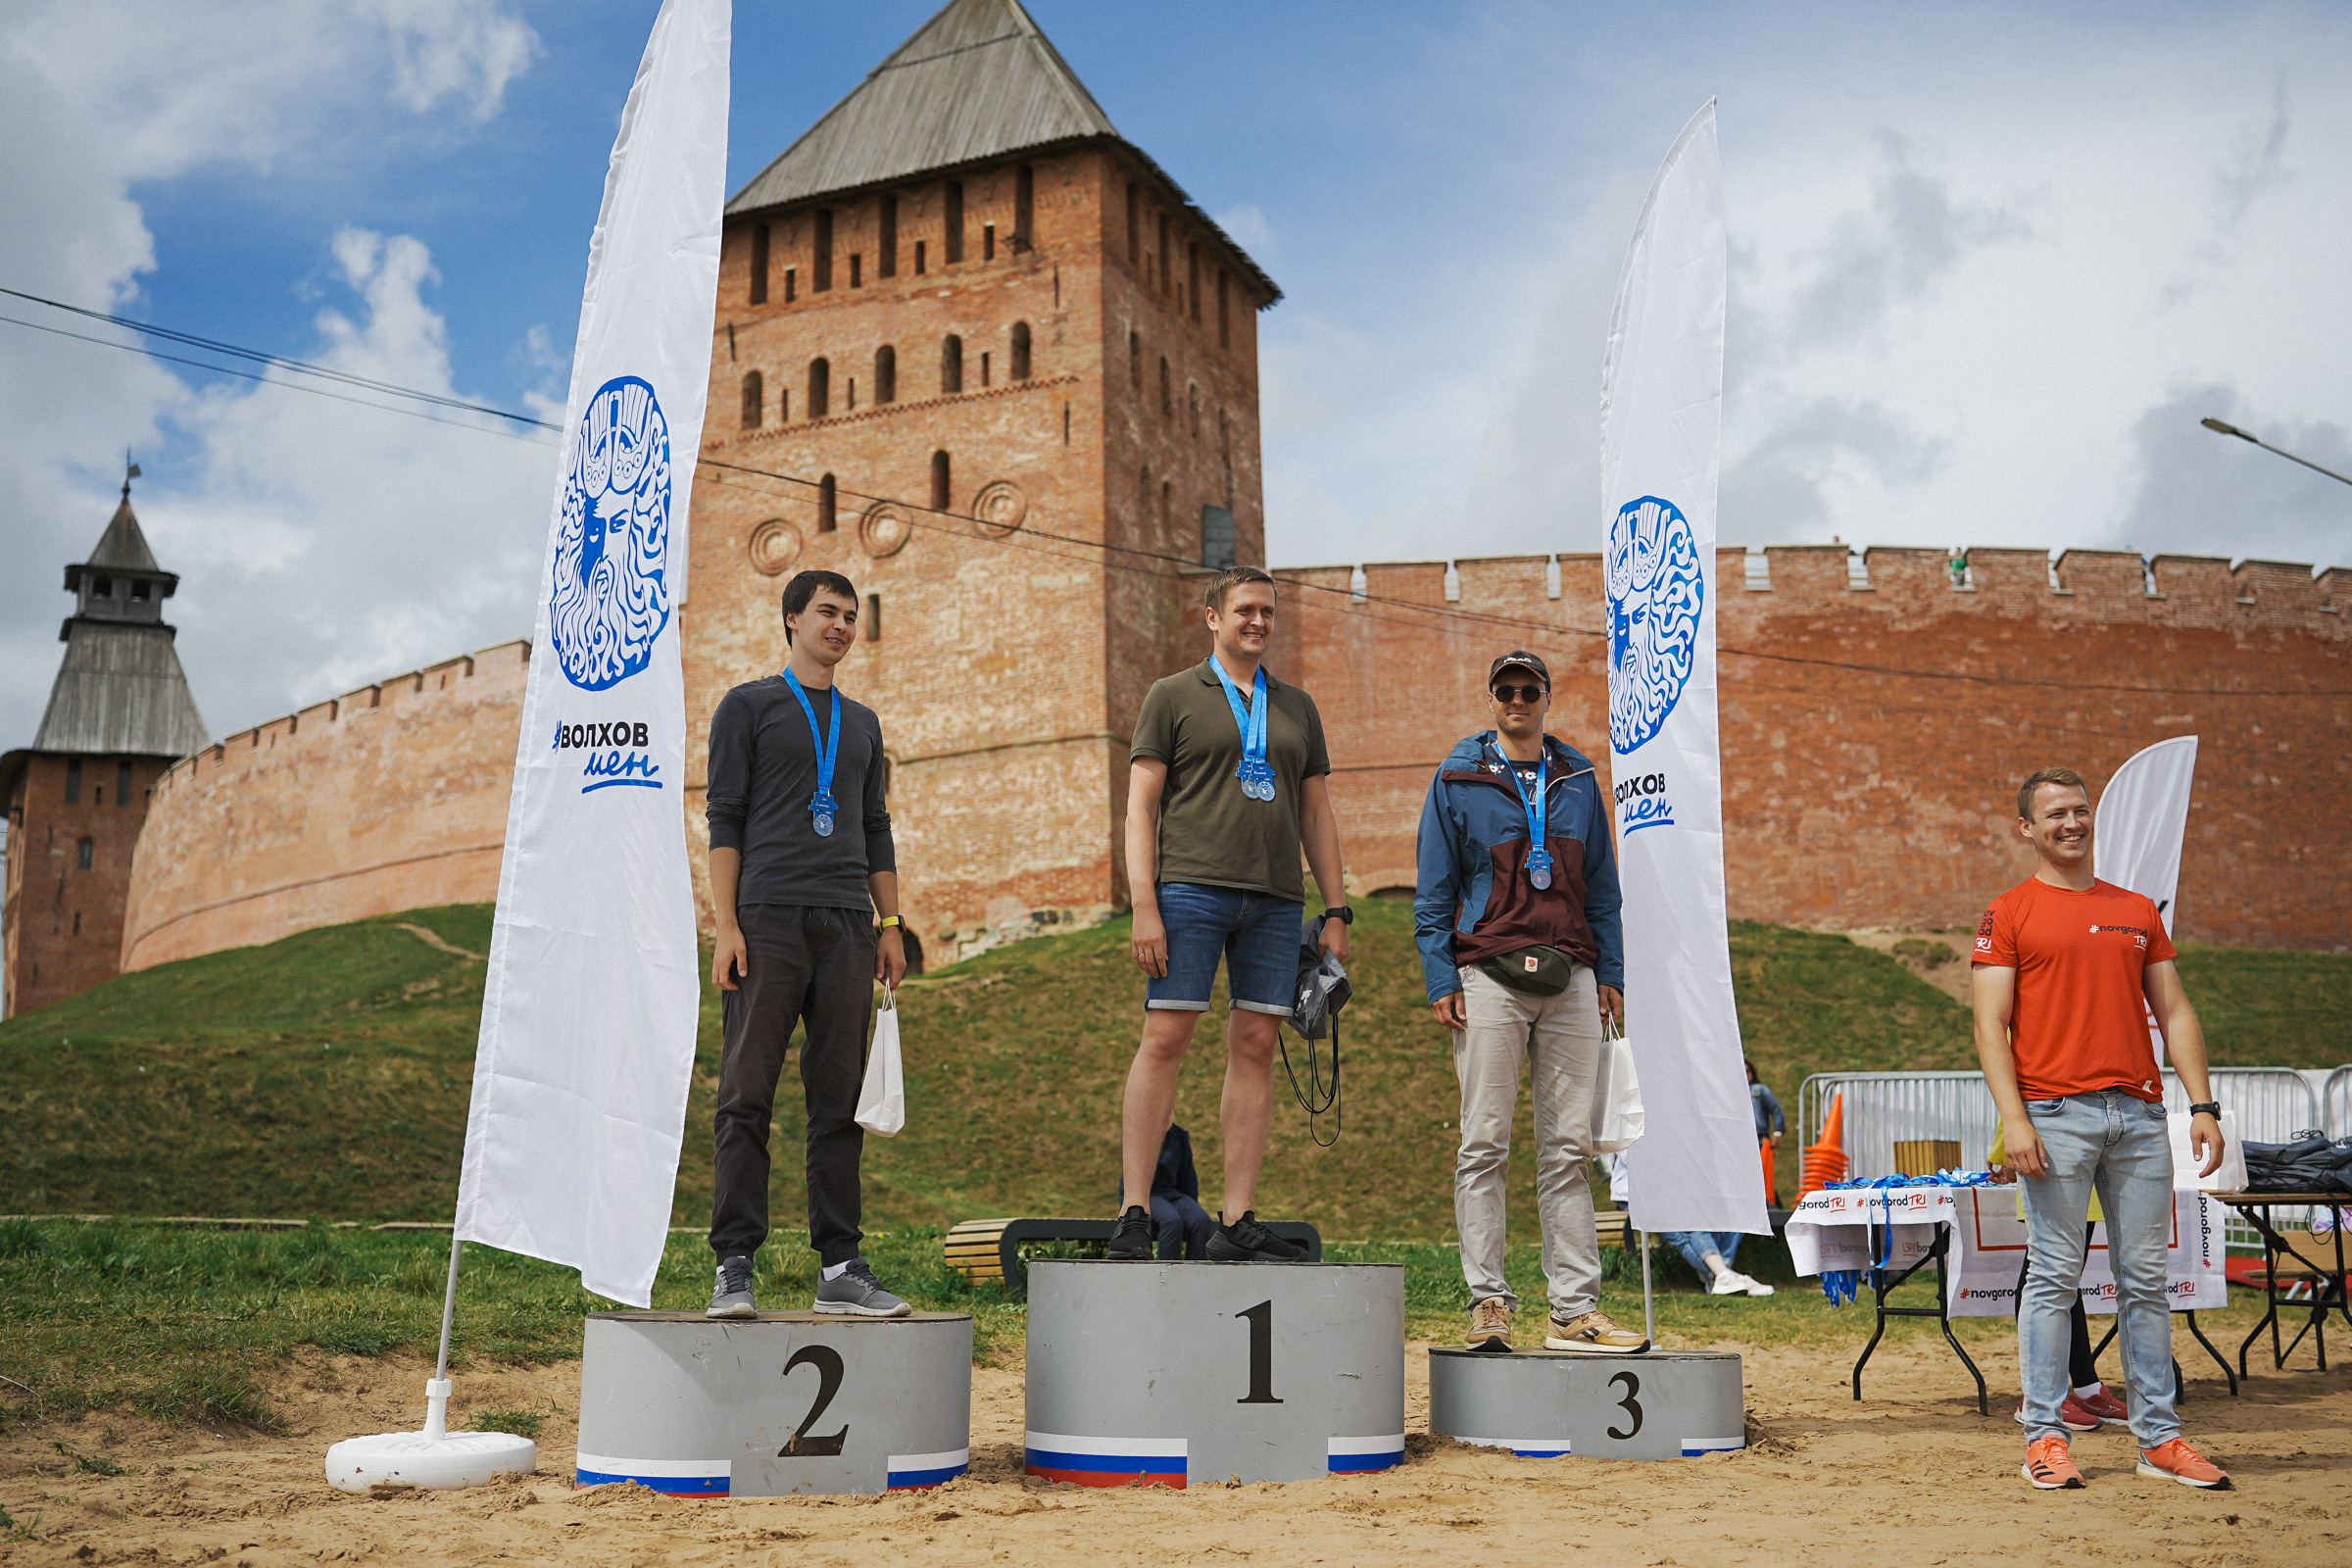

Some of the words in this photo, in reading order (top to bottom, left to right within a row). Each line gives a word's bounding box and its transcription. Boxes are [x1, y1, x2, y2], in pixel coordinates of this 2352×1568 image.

[2088, 924, 2148, 938] #novgorod
[1959, 1288, 2019, 1301] #novgoro
[1235, 1299, 1284, 1403] 1
[777, 1345, 850, 1458] 2
[1606, 1371, 1643, 1440] 3
